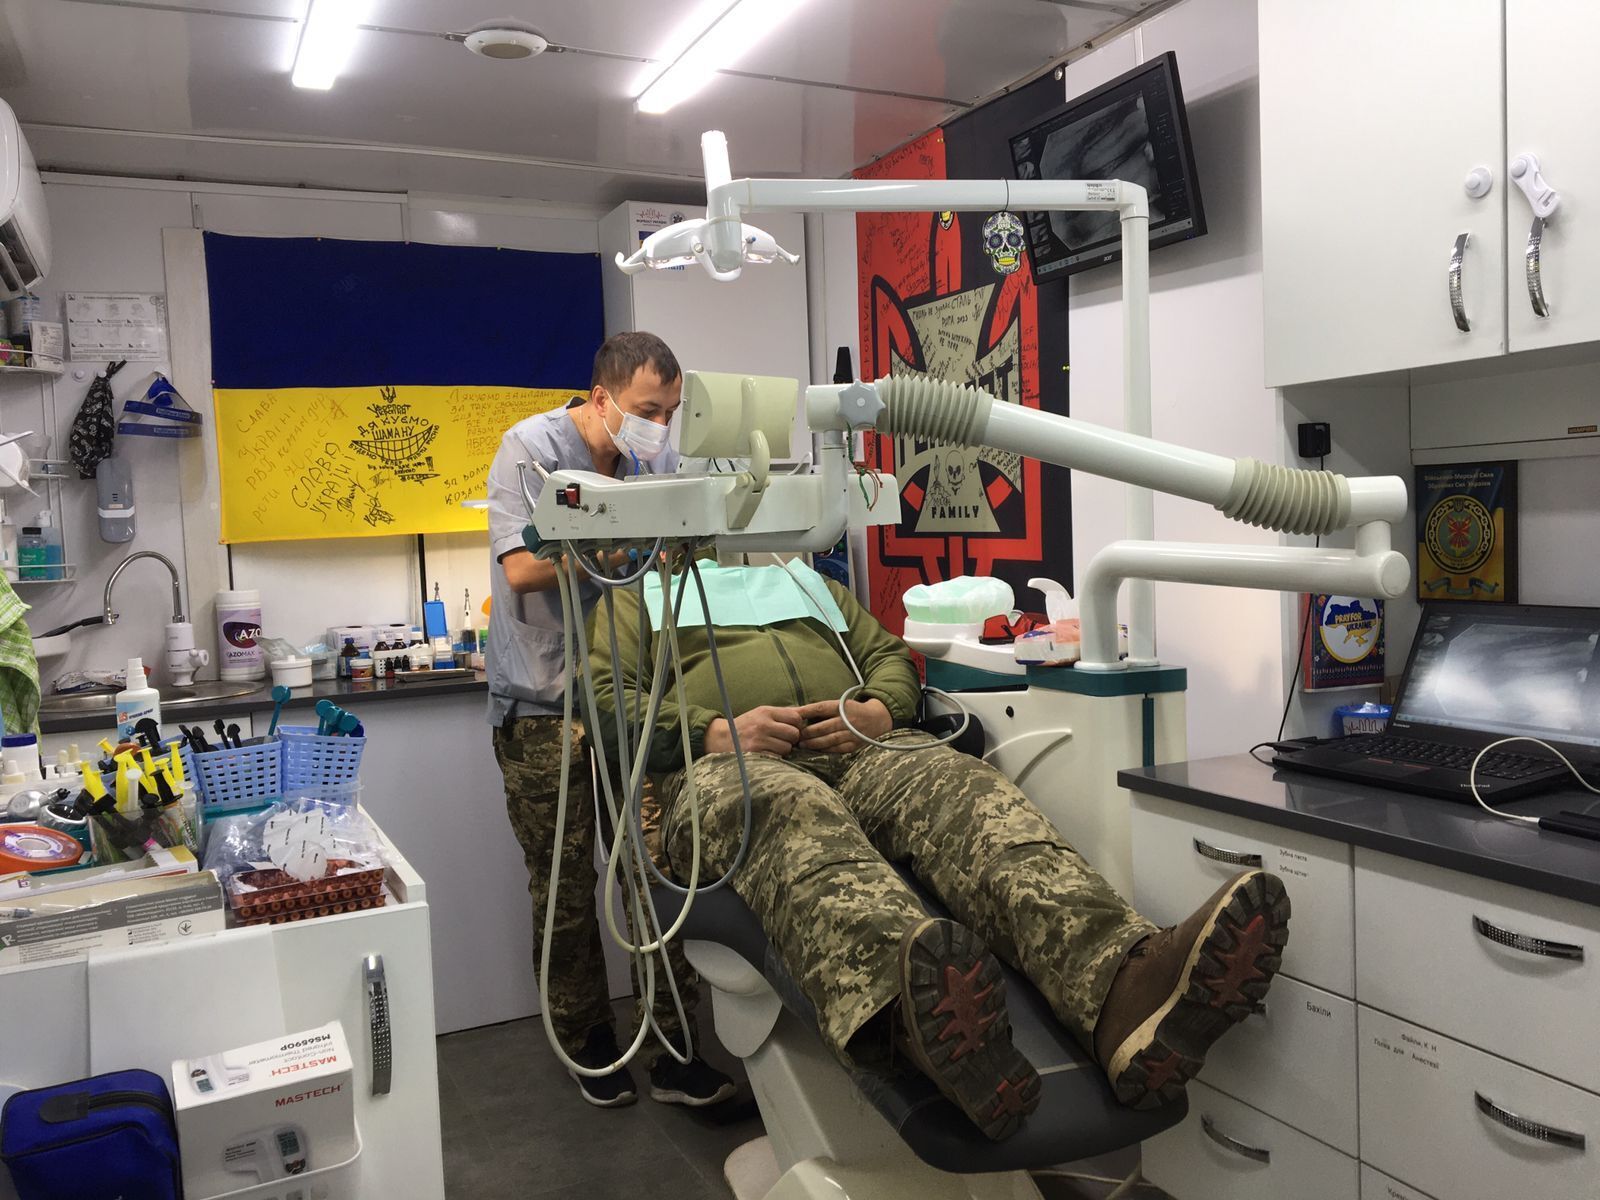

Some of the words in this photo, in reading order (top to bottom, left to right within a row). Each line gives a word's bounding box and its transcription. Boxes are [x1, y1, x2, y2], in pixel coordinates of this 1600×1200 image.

[371, 426, 415, 440] ШАМАНУ
[931, 505, 980, 519] FAMILY
[1350, 612, 1362, 622] FOR
[1306, 1000, 1332, 1018] Бахіли
[302, 1041, 333, 1053] Infrared
[248, 1050, 301, 1066] Thermometer
[271, 1055, 337, 1077] MASTECH
[275, 1084, 342, 1108] MASTECH
